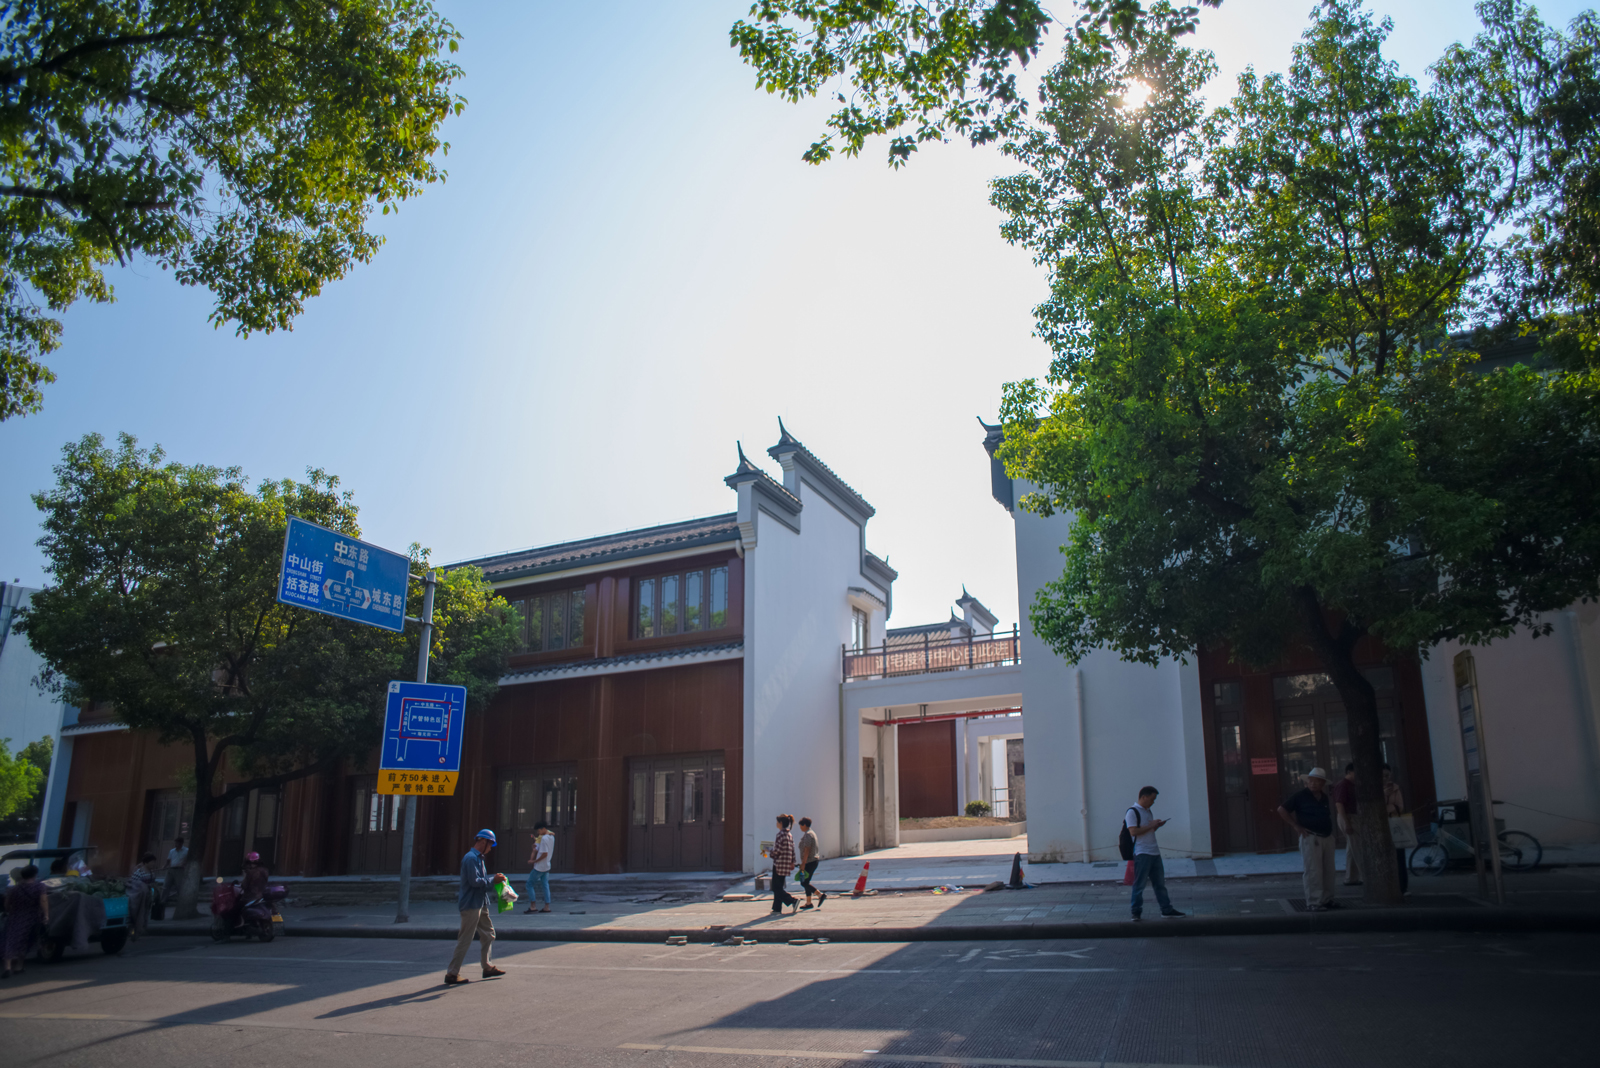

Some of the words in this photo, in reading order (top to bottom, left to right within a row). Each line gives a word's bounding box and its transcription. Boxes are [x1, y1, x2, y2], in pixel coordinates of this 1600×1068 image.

[288, 553, 323, 574] 中山街
[334, 541, 369, 565] 中东路
[285, 591, 306, 600] KUOCANG
[286, 576, 319, 597] 括苍路
[372, 588, 402, 610] 城东路
[388, 772, 451, 783] 前方50米进入
[391, 783, 446, 793] 严管特色区
